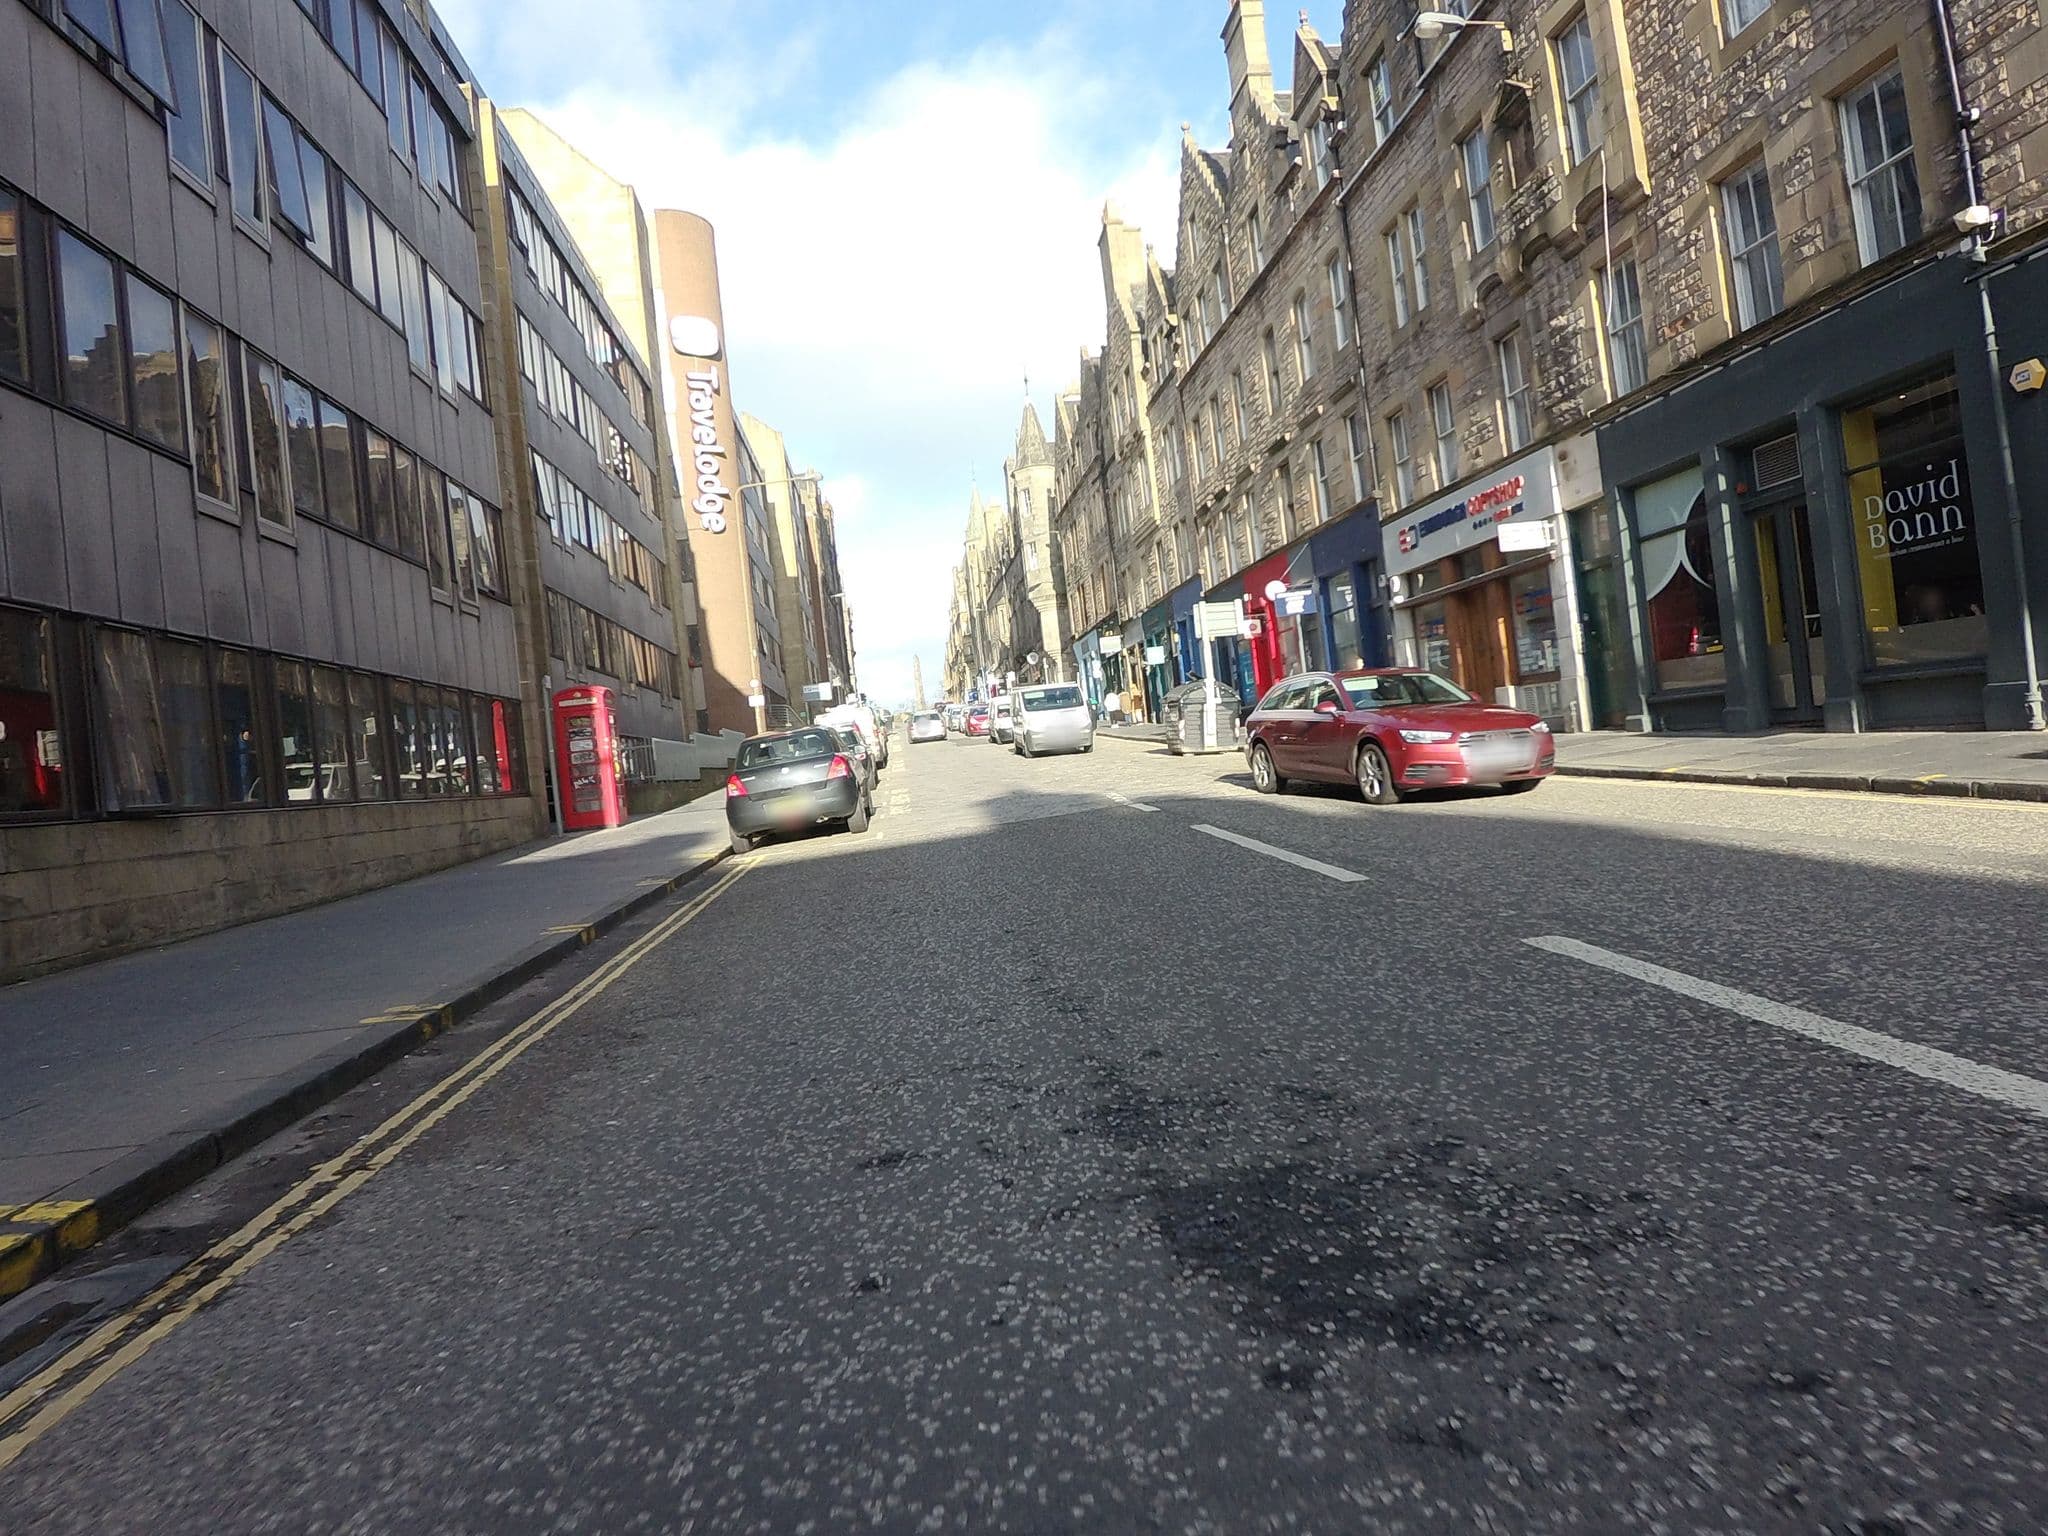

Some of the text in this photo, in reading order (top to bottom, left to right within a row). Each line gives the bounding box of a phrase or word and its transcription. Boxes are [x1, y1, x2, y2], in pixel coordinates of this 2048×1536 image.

[686, 365, 731, 534] Travelodge
[1863, 458, 1960, 521] David
[1867, 505, 1966, 549] Bann
